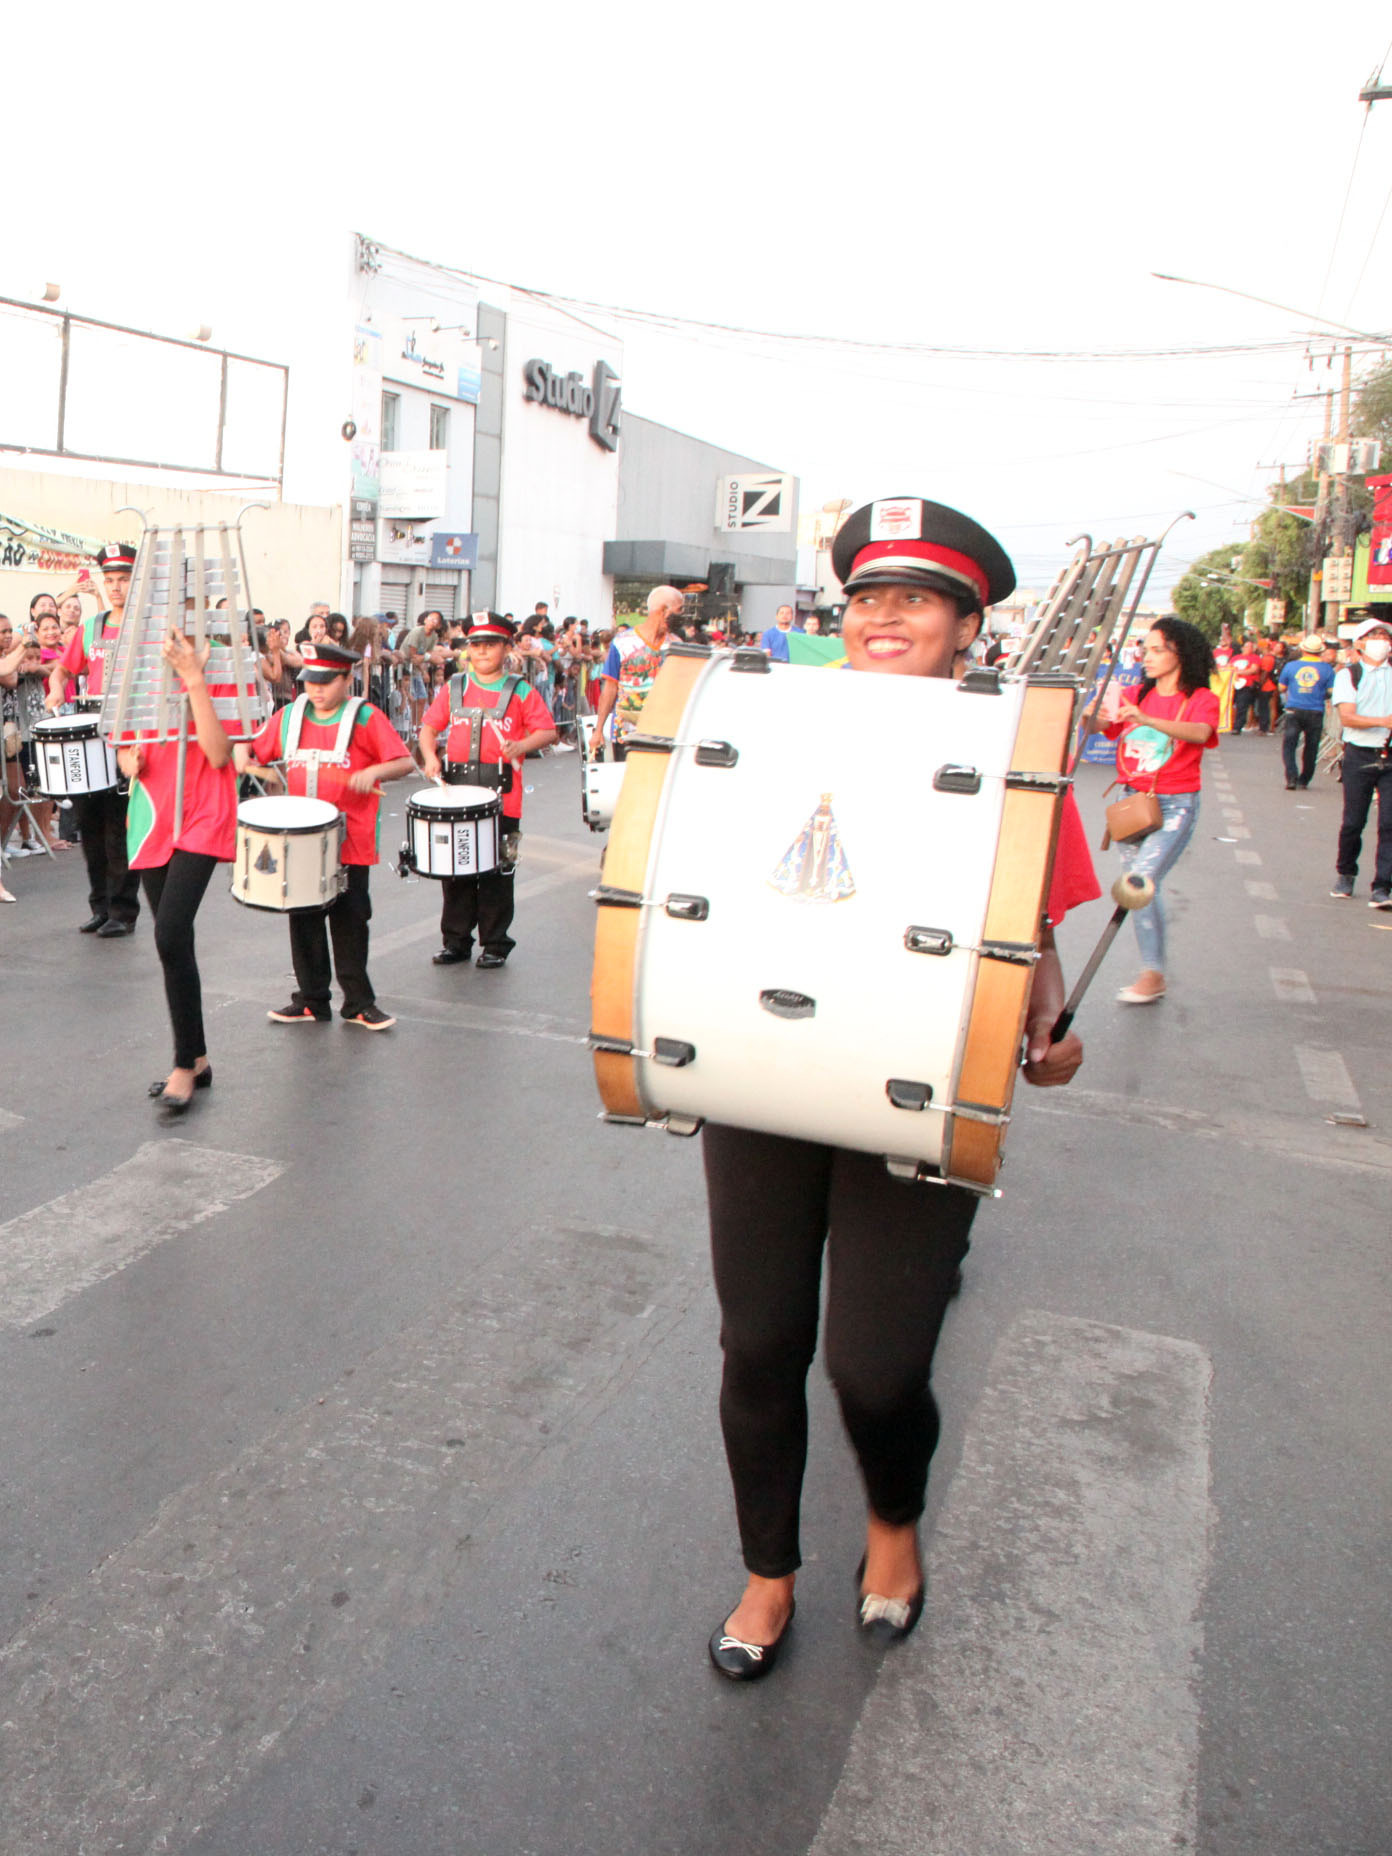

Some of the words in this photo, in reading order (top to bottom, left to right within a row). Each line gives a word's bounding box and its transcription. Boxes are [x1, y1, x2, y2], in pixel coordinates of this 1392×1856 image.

[523, 358, 594, 418] Studio
[727, 481, 739, 528] STUDIO
[437, 556, 470, 565] Loterias
[68, 748, 83, 783] STANFORD
[457, 829, 470, 866] STANFORD
